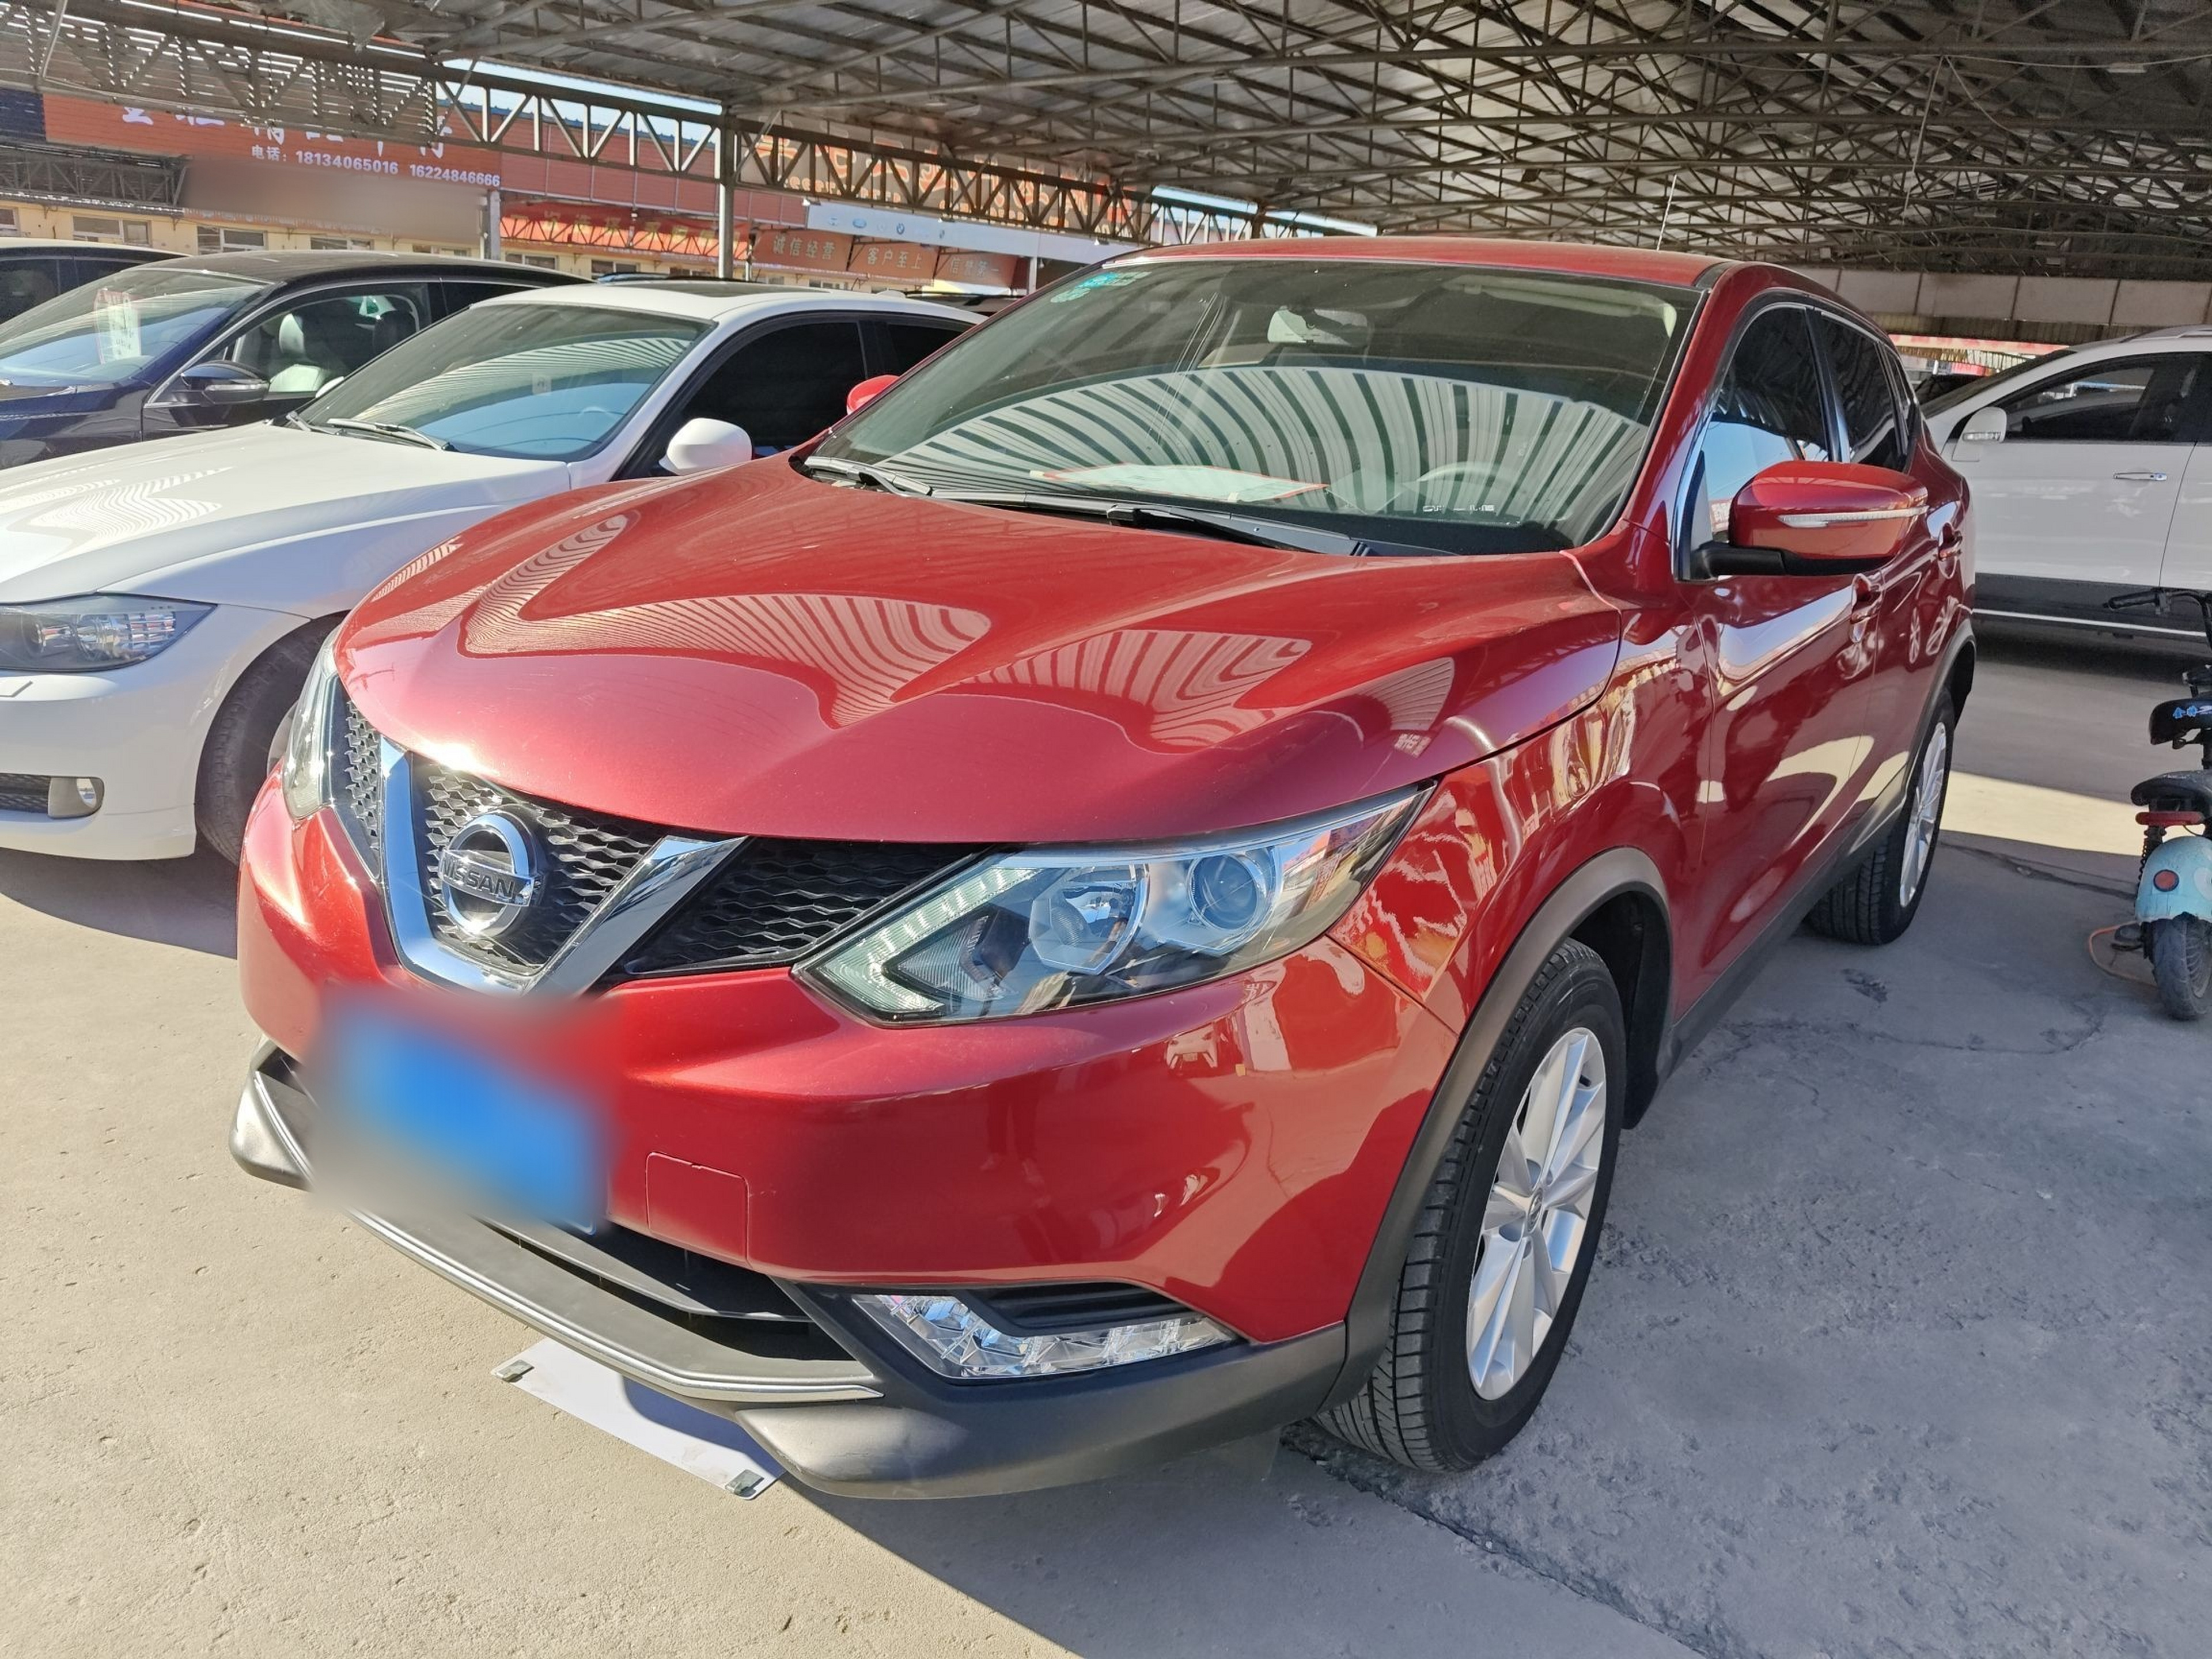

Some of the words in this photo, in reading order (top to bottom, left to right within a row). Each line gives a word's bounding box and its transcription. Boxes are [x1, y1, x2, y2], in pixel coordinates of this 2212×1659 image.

[296, 150, 399, 175] 18134065016
[410, 164, 500, 187] 16224846666
[772, 234, 835, 260] 诚信经营
[867, 247, 922, 269] 客户至上
[442, 858, 514, 900] NISSAN
